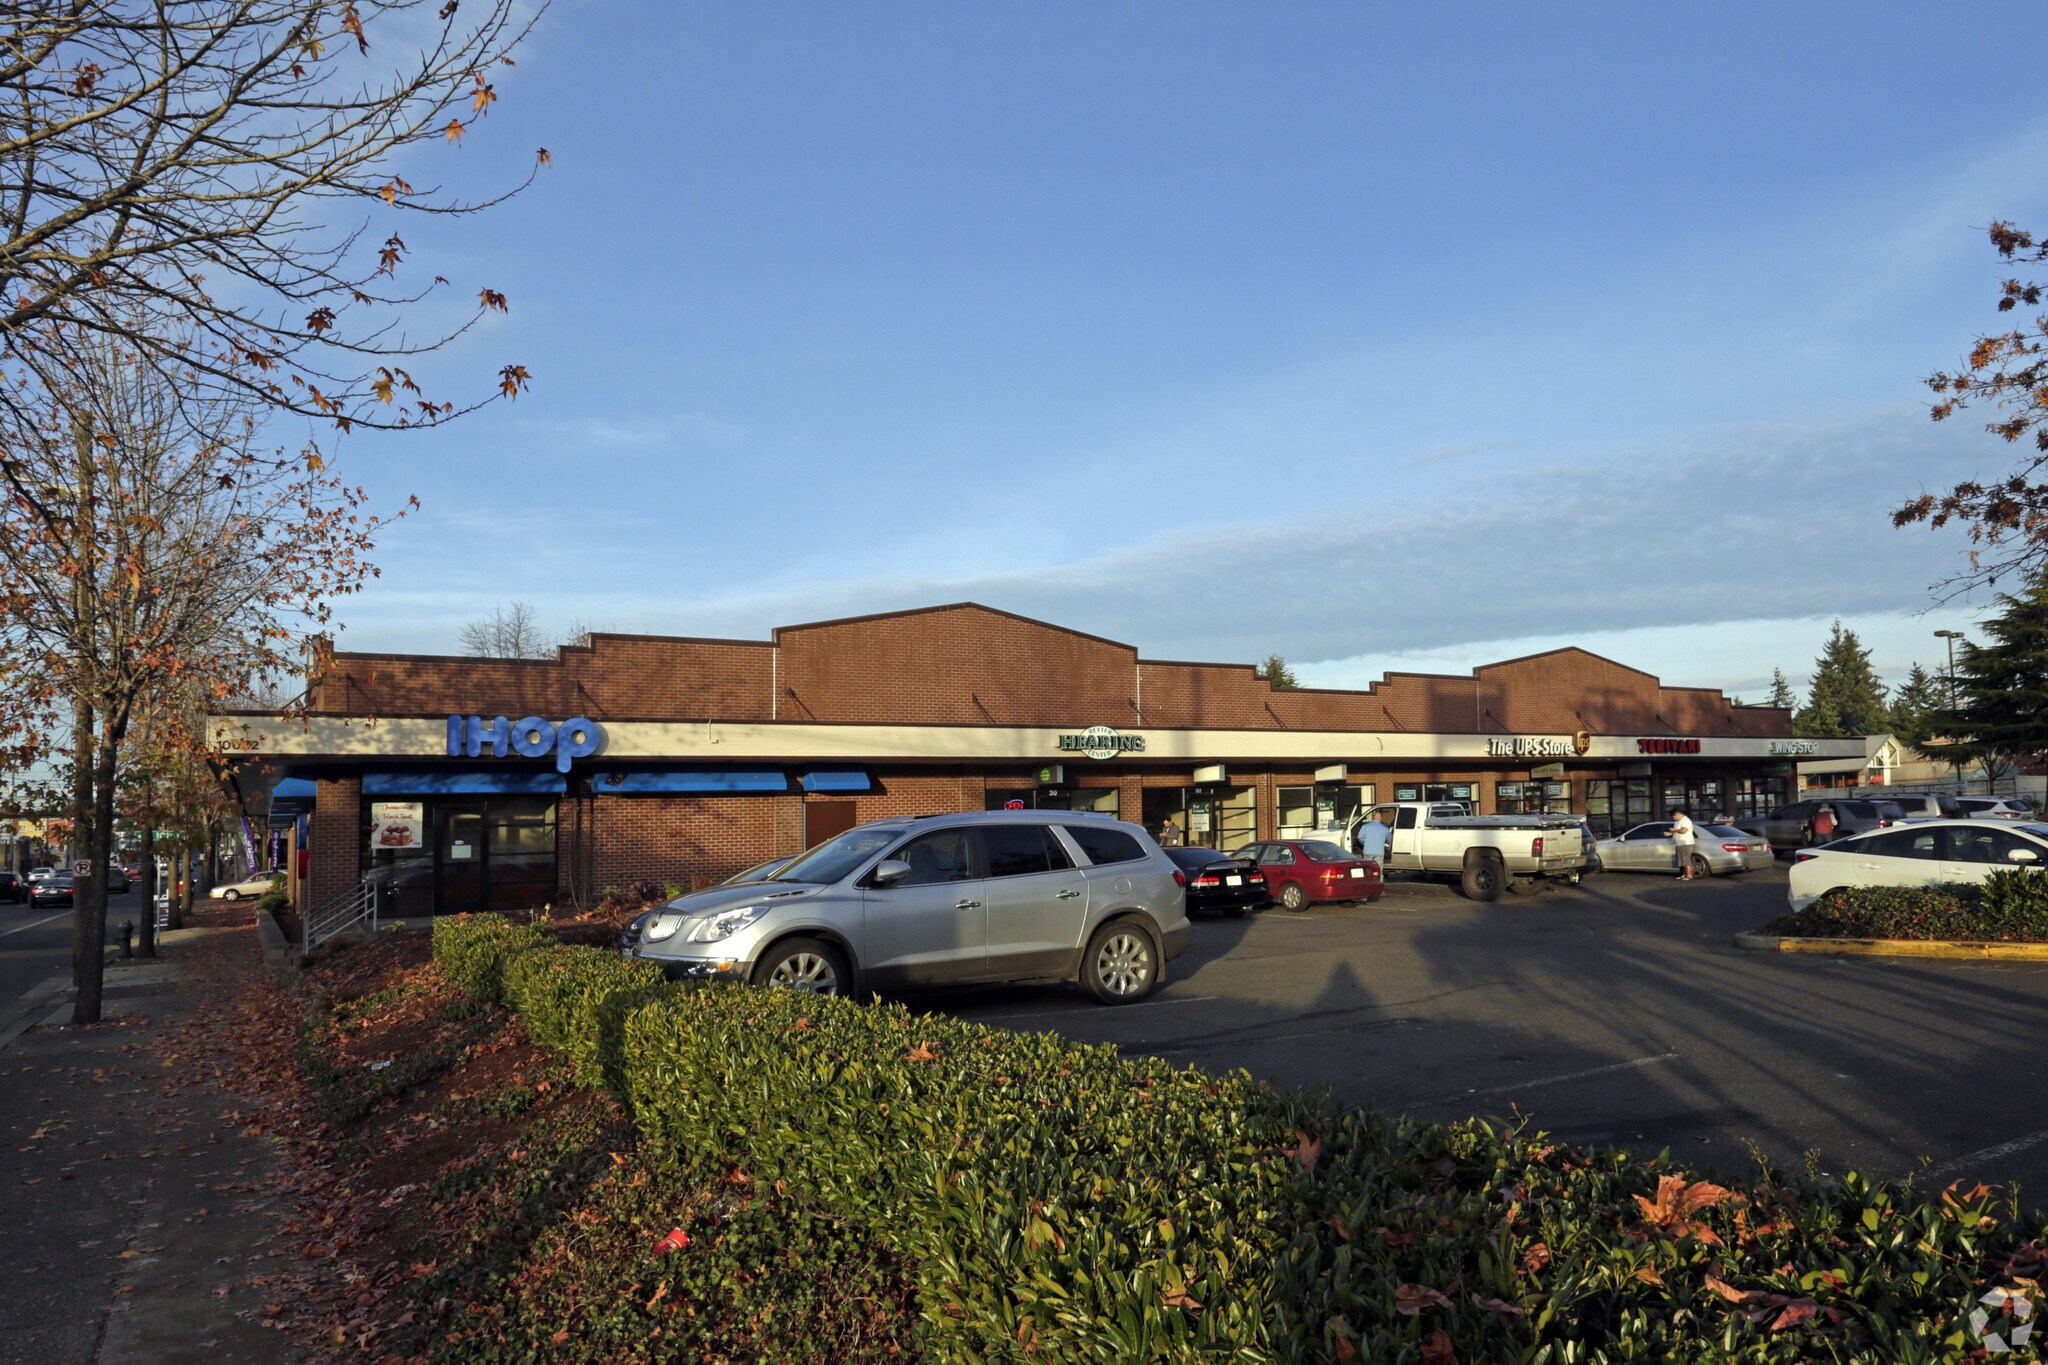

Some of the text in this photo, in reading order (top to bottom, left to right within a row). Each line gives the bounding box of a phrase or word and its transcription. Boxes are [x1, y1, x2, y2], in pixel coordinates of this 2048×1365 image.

[216, 740, 260, 751] 1002
[446, 714, 600, 773] IHOP
[1060, 735, 1144, 750] HEARING
[1491, 738, 1572, 755] The UPS Store
[1639, 738, 1701, 754] TERIYAKI
[1087, 749, 1113, 758] CENTER
[1048, 789, 1058, 797] 30
[1003, 801, 1024, 811] OPEN
